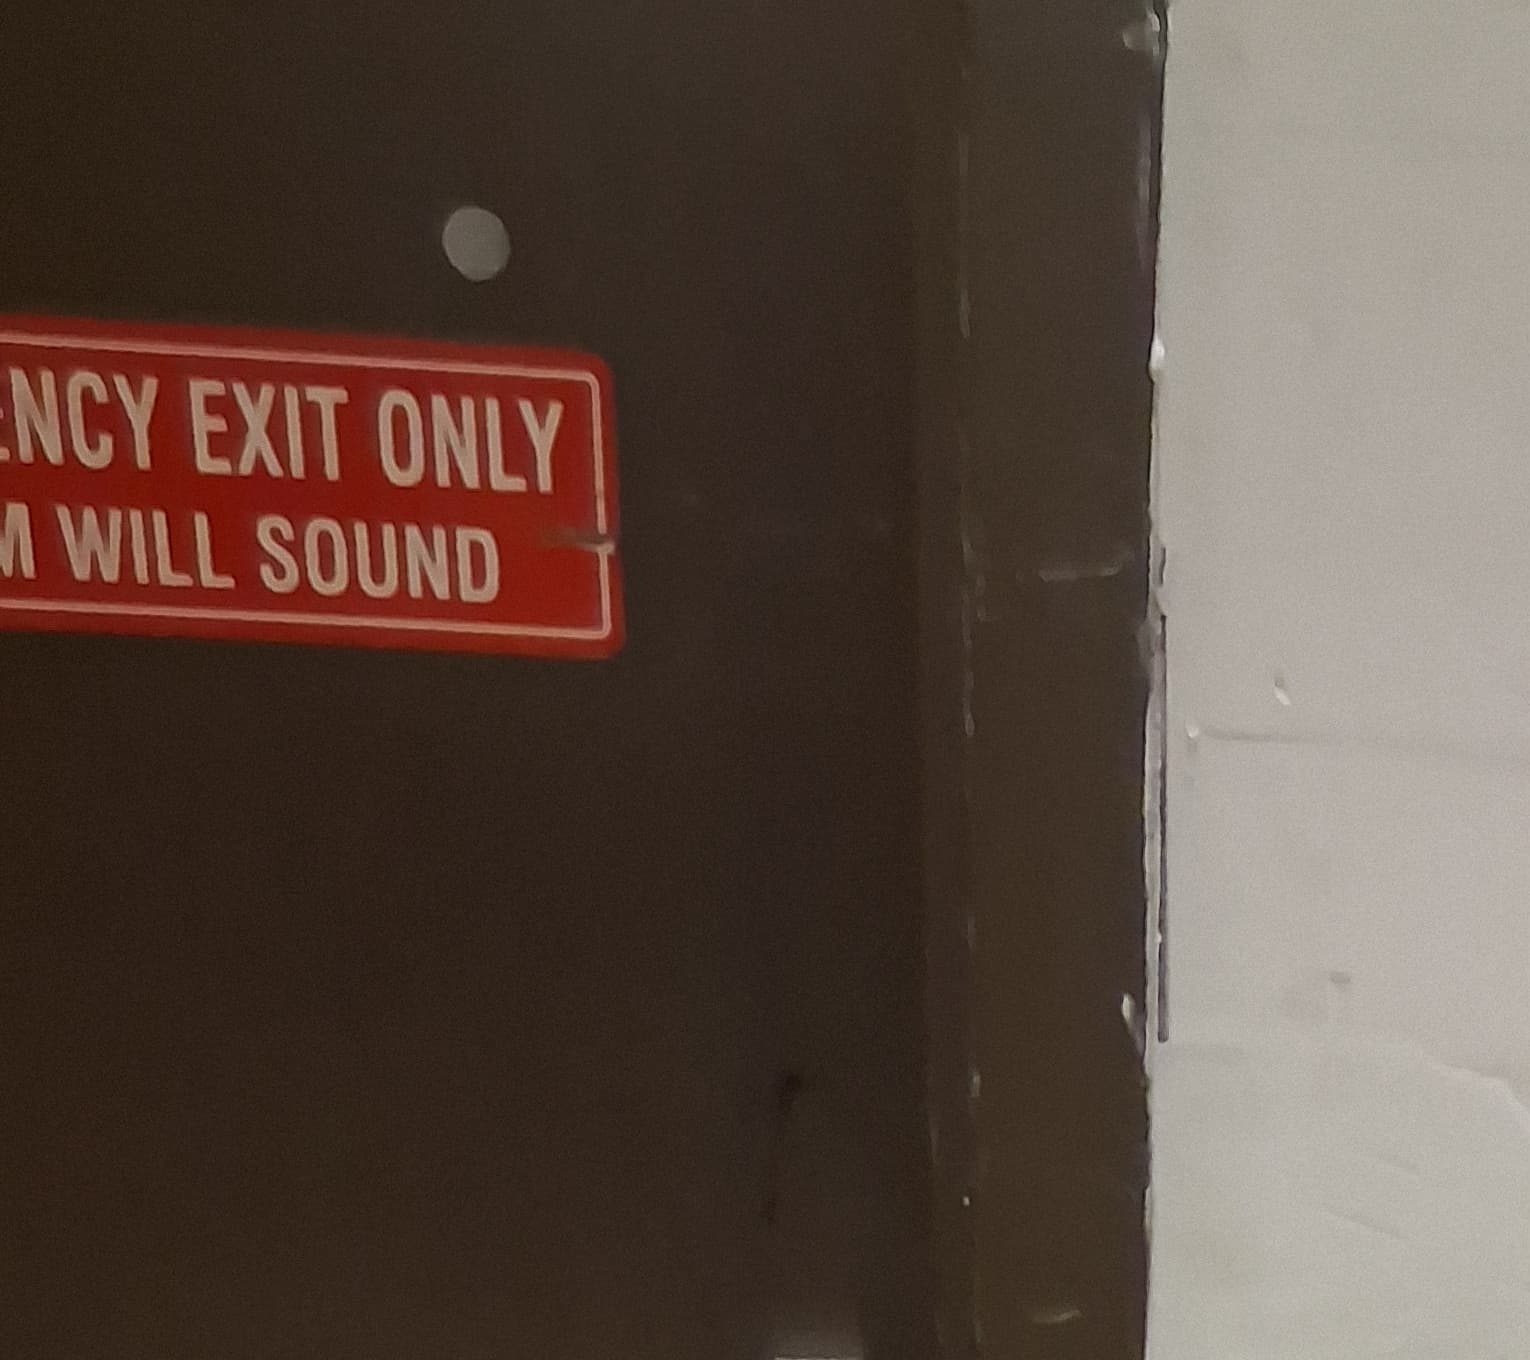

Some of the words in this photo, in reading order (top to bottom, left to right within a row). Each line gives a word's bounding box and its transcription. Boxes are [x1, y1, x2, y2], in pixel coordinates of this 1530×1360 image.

[0, 366, 158, 470] NCY
[189, 378, 349, 481] EXIT
[377, 388, 564, 494] ONLY
[56, 503, 236, 589] WILL
[256, 513, 500, 603] SOUND
